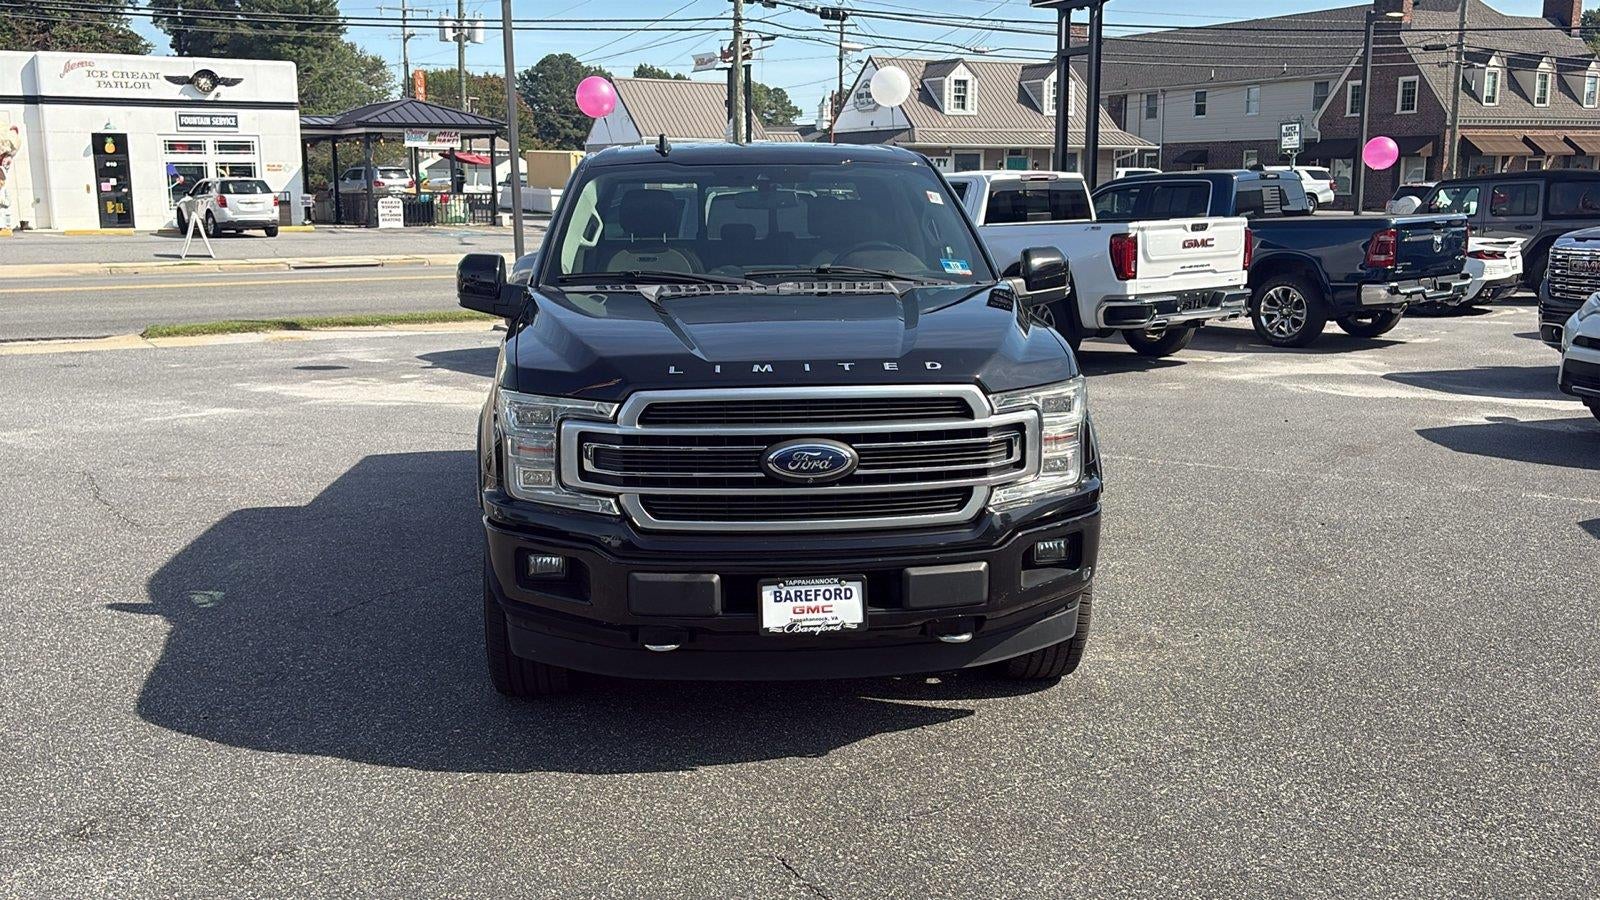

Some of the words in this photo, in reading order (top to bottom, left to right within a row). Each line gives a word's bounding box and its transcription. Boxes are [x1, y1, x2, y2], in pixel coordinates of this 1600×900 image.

[86, 69, 108, 79] ICE
[111, 70, 161, 80] CREAM
[96, 80, 151, 90] PARLOR
[180, 116, 211, 125] FOUNTAIN
[211, 116, 237, 126] SERVICE
[1182, 238, 1215, 249] GMC
[668, 360, 943, 375] LIMITED
[787, 451, 833, 471] Ford
[784, 577, 839, 586] TAPPAHANNOCK
[773, 587, 853, 603] BAREFORD
[792, 604, 834, 615] GMC
